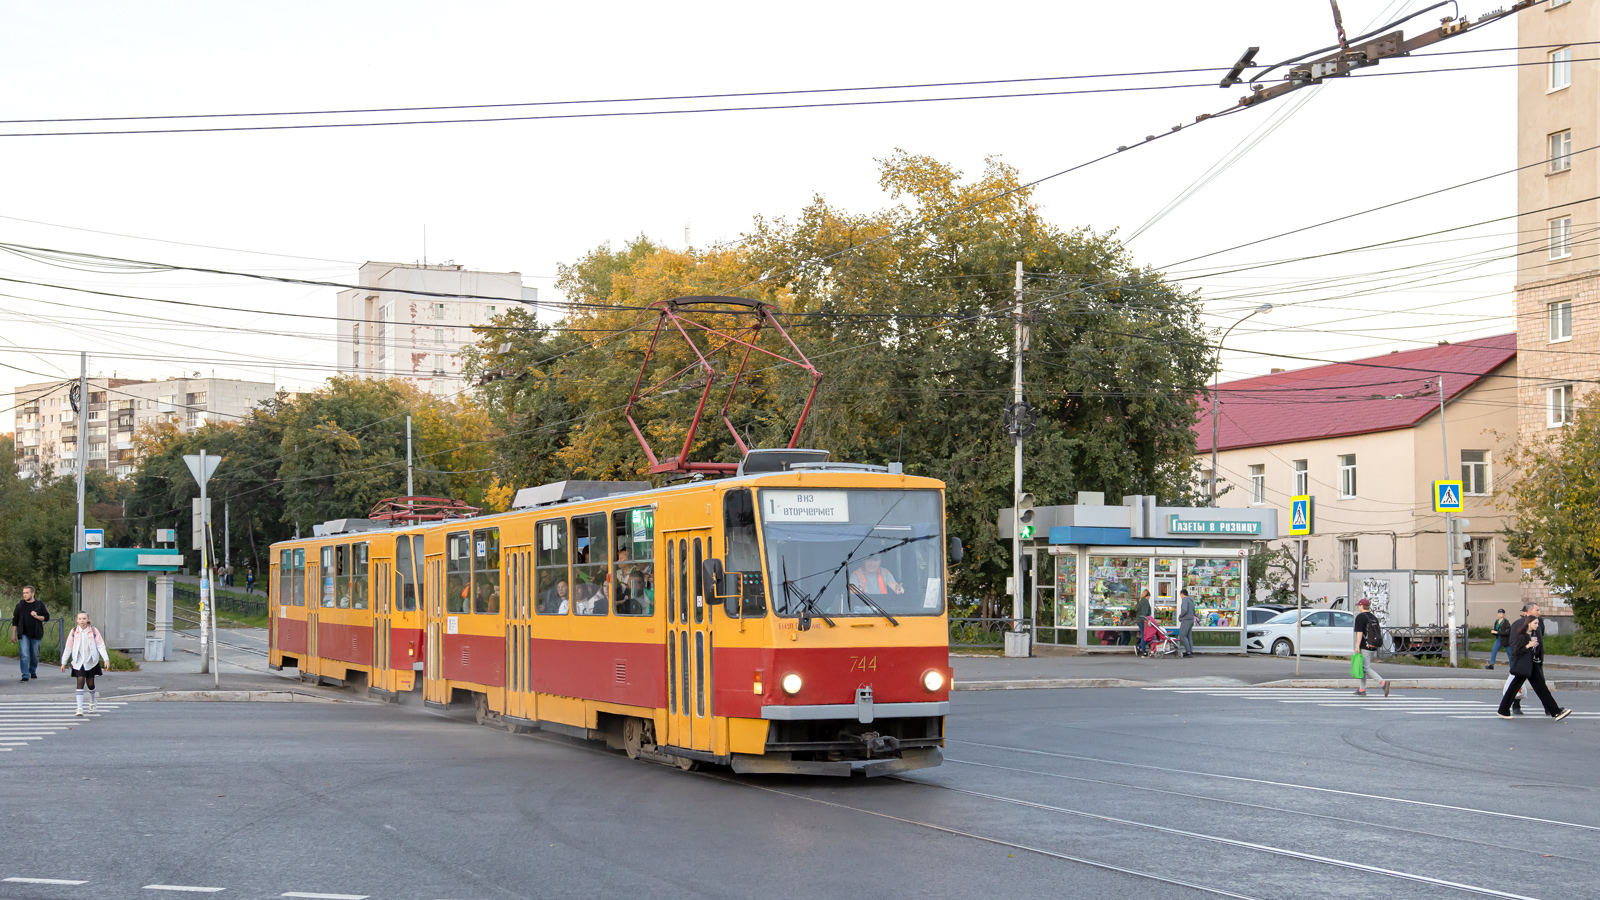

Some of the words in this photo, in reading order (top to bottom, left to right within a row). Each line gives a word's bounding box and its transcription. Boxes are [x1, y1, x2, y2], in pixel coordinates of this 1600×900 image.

[797, 494, 814, 502] ВИЗ
[770, 499, 775, 514] 1
[850, 655, 877, 672] 744
